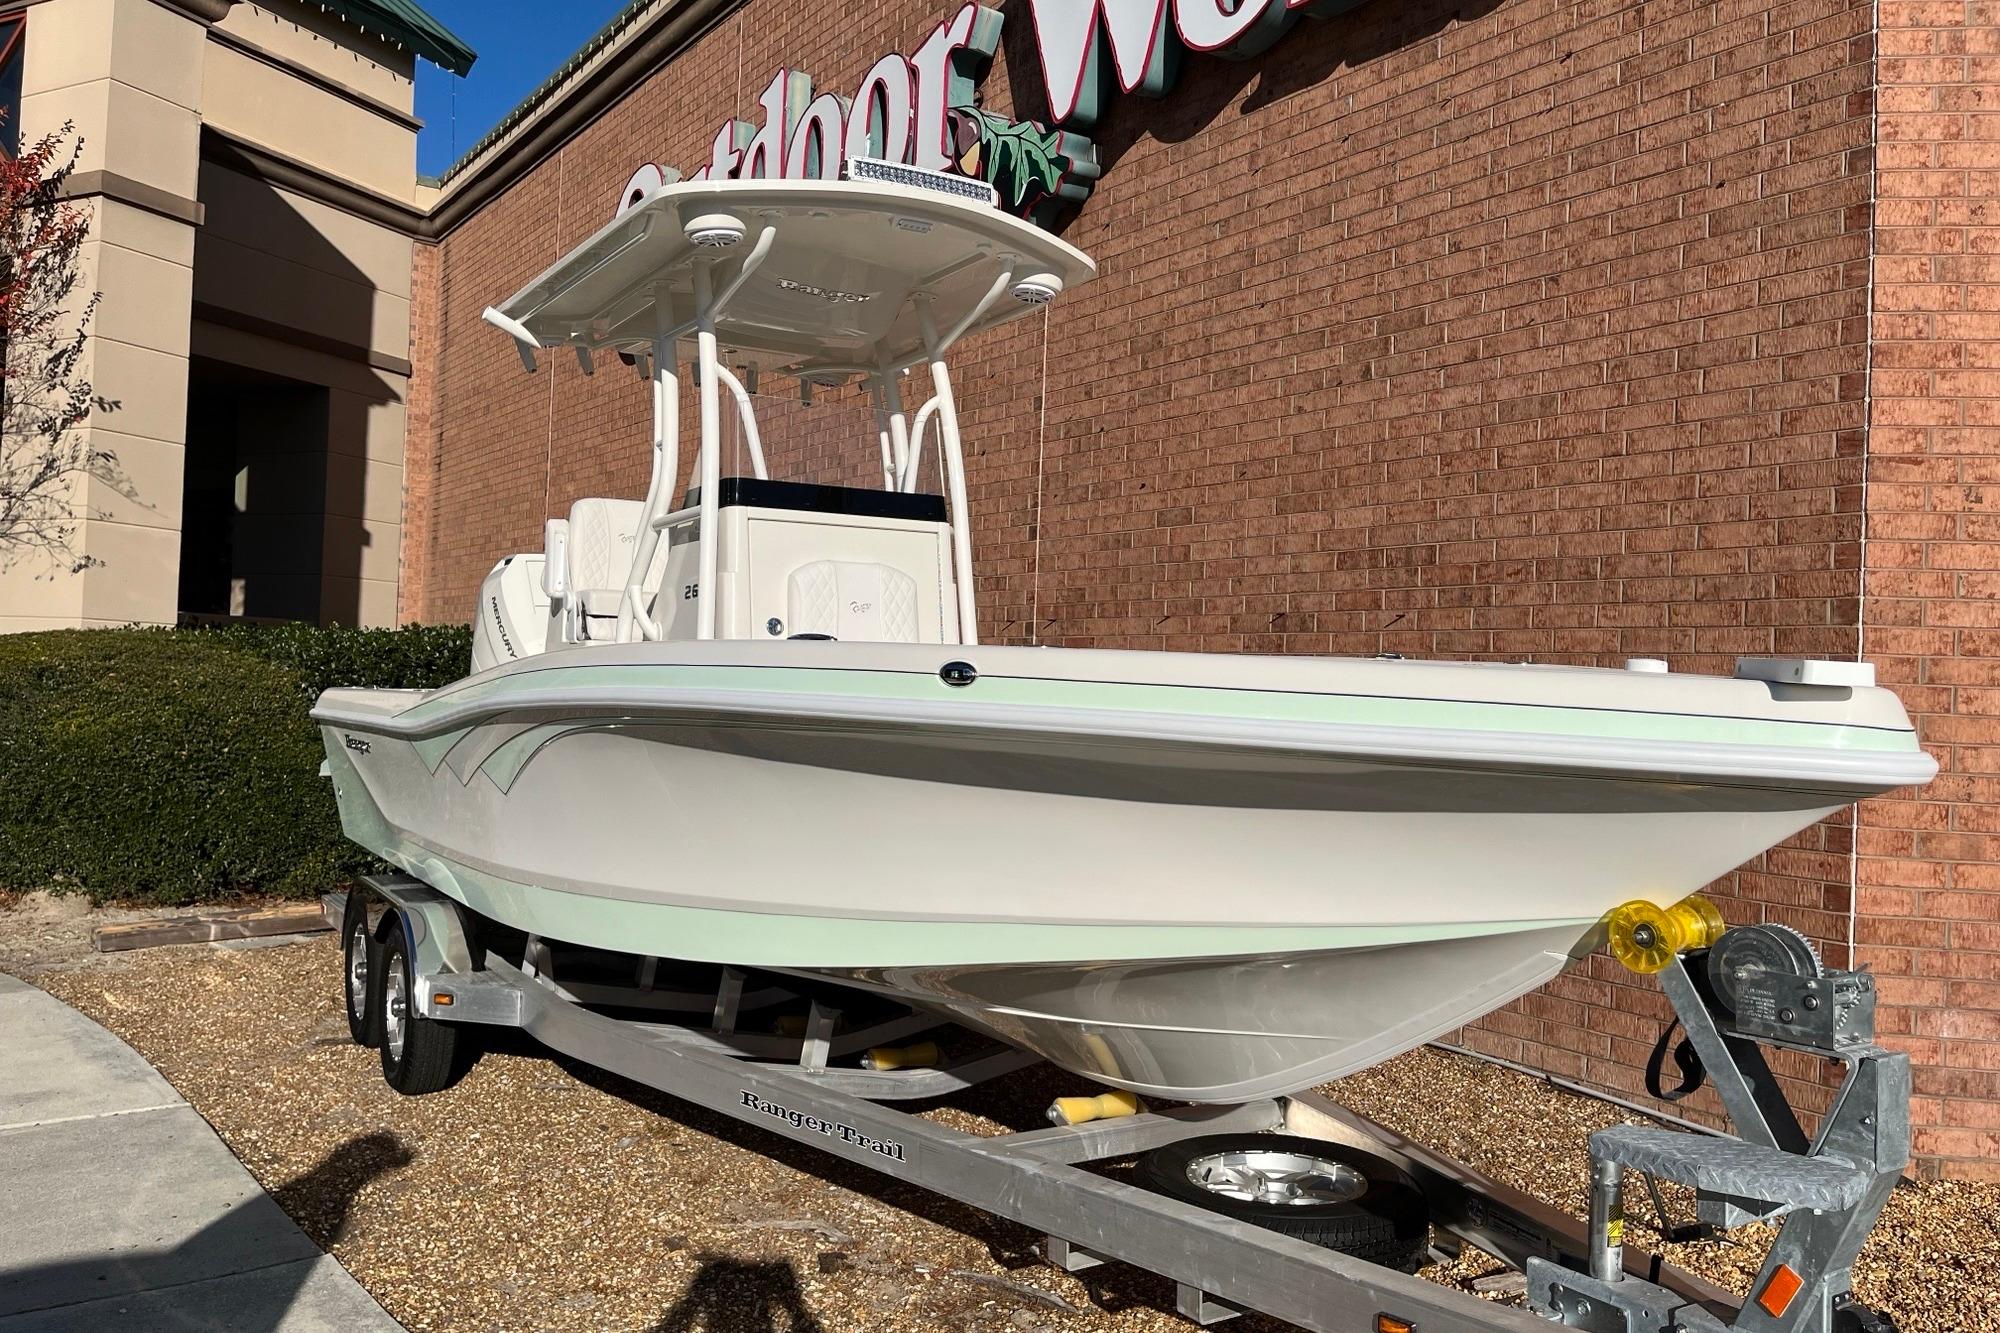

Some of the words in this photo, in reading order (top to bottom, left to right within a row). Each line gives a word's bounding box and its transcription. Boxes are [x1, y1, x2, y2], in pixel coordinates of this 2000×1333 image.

[776, 278, 870, 303] Ranger
[491, 596, 518, 658] MERCURY
[740, 1089, 834, 1136] Ranger
[835, 1122, 906, 1163] Trail
